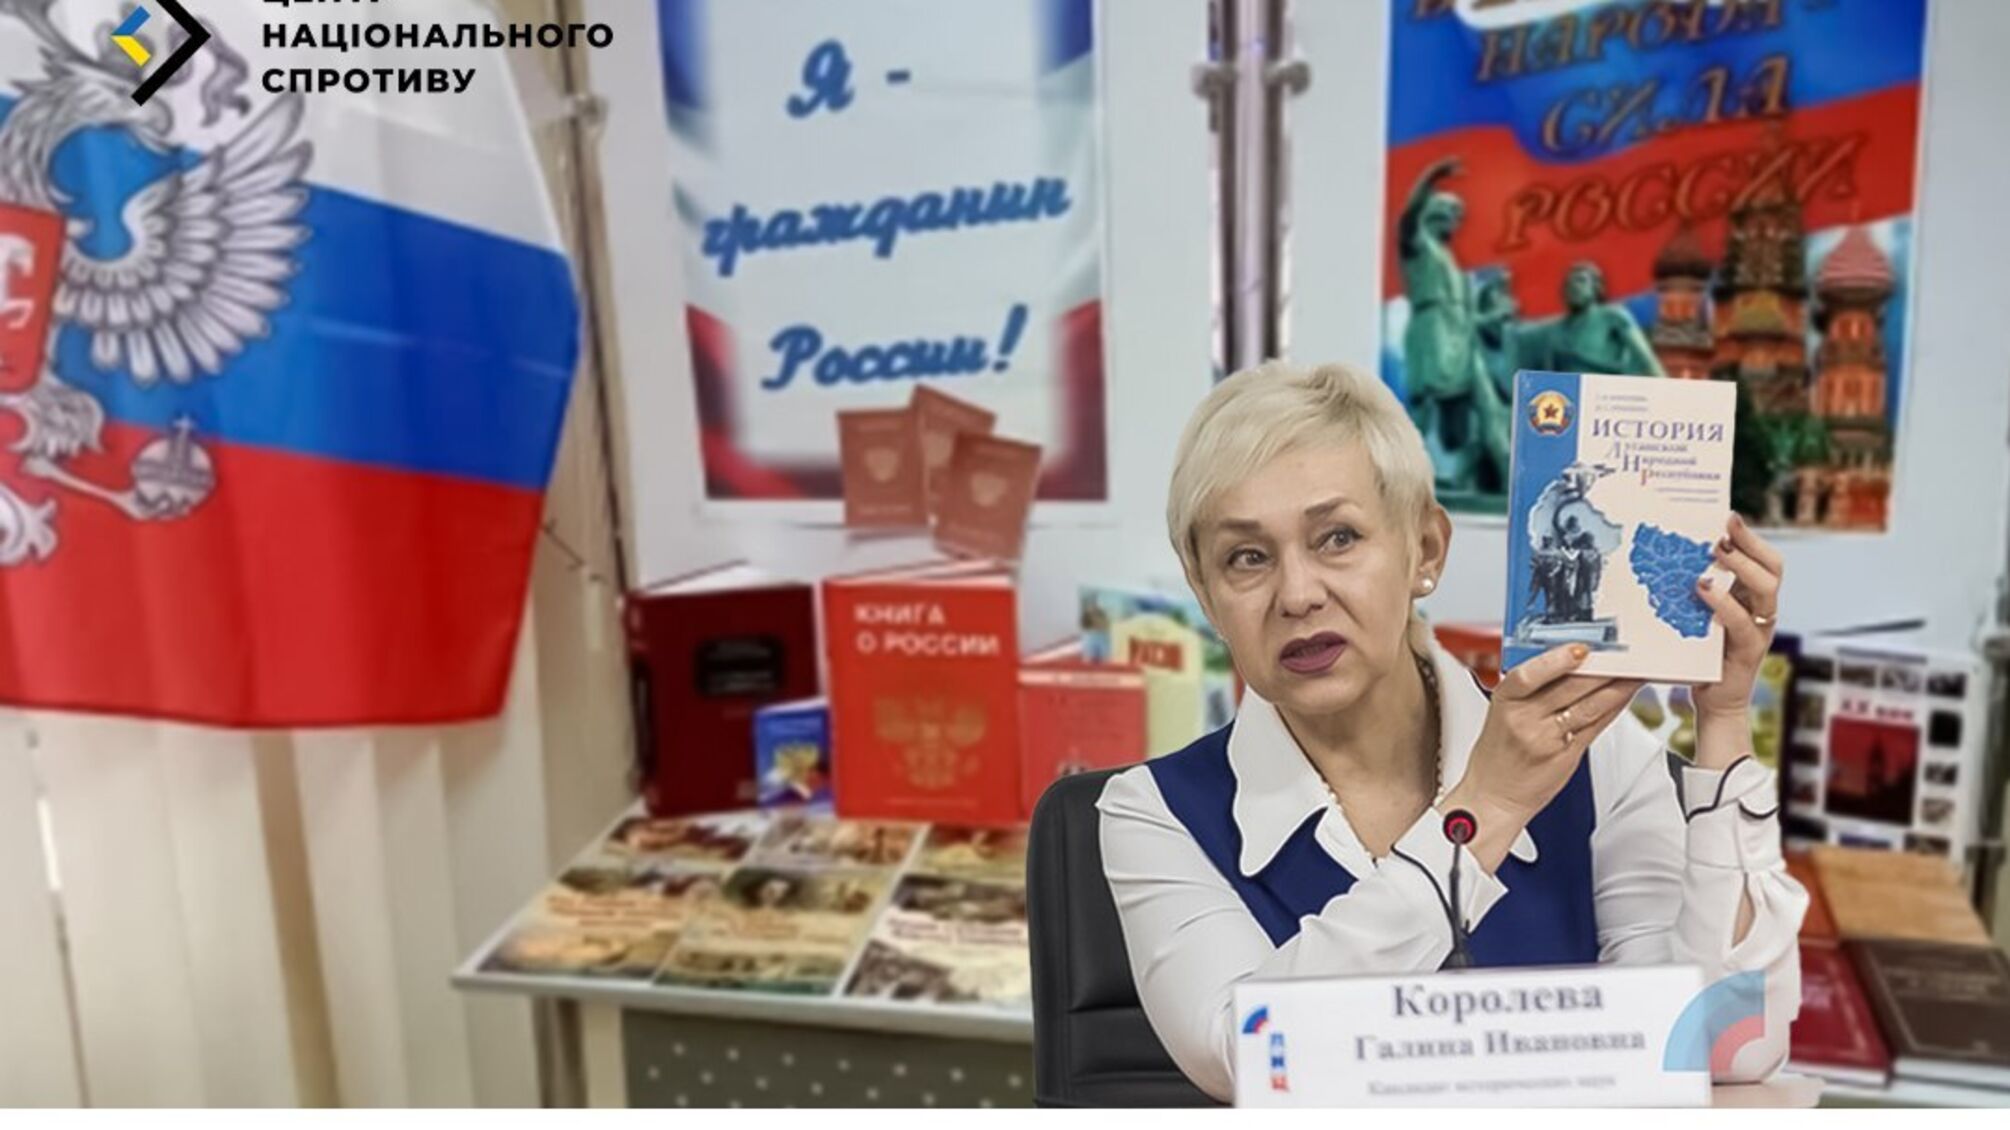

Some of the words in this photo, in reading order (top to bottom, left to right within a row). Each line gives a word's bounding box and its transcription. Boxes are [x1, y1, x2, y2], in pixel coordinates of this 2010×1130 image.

[787, 40, 854, 118] Я
[1499, 132, 1868, 253] РОССИИ
[702, 177, 1071, 278] гражданин
[761, 304, 1029, 390] России!
[1592, 419, 1724, 442] ИСТОРИЯ
[854, 602, 946, 626] КНИГА
[884, 630, 999, 657] РОССИИ
[1393, 983, 1605, 1025] Королева
[1353, 1033, 1476, 1062] Галина
[1484, 1028, 1647, 1056] Ивановна
